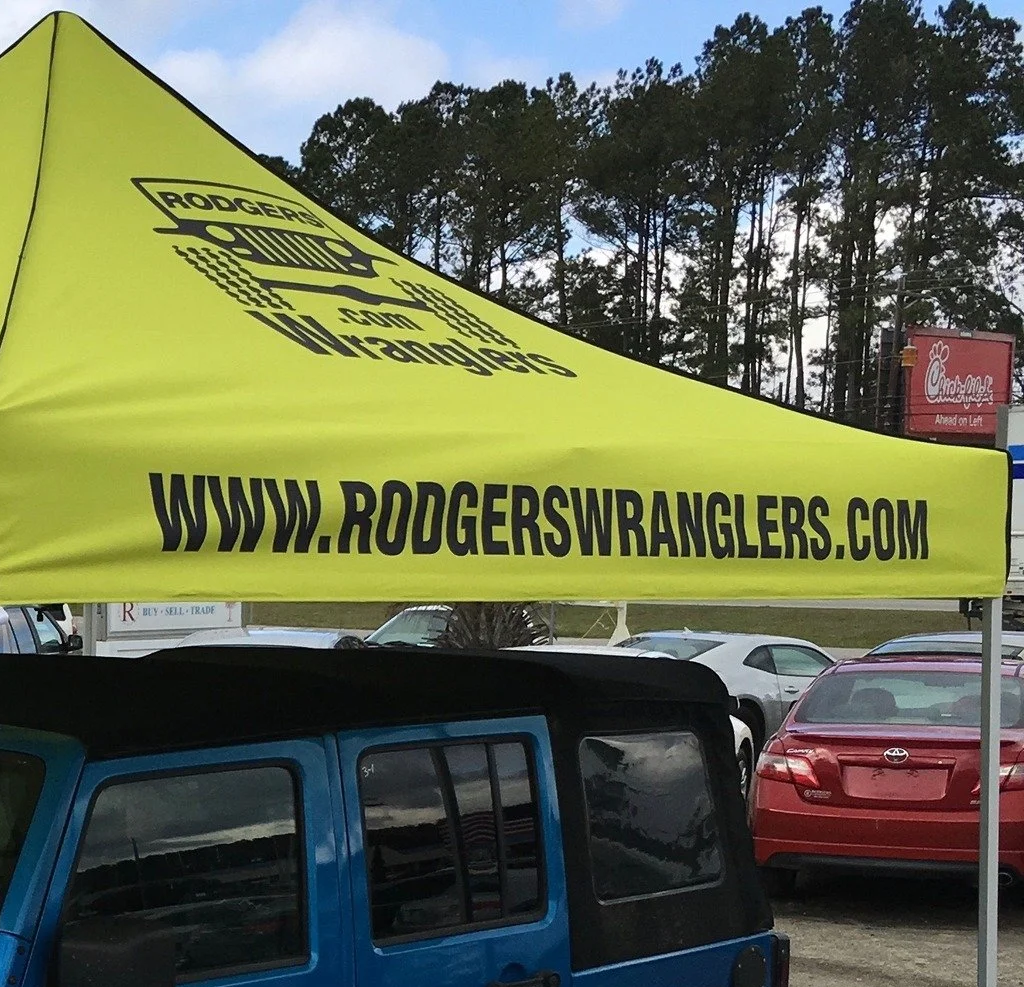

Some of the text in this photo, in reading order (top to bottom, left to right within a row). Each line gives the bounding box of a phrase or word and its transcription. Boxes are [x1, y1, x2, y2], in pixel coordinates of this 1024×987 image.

[156, 190, 325, 229] RODGERS
[338, 307, 425, 332] .com
[244, 309, 578, 377] Wranglers
[935, 414, 983, 427] Ahead on Left
[148, 473, 929, 562] WWW.RODGERSWRANGLERS.COM
[142, 605, 215, 616] BUY SELL TRADE
